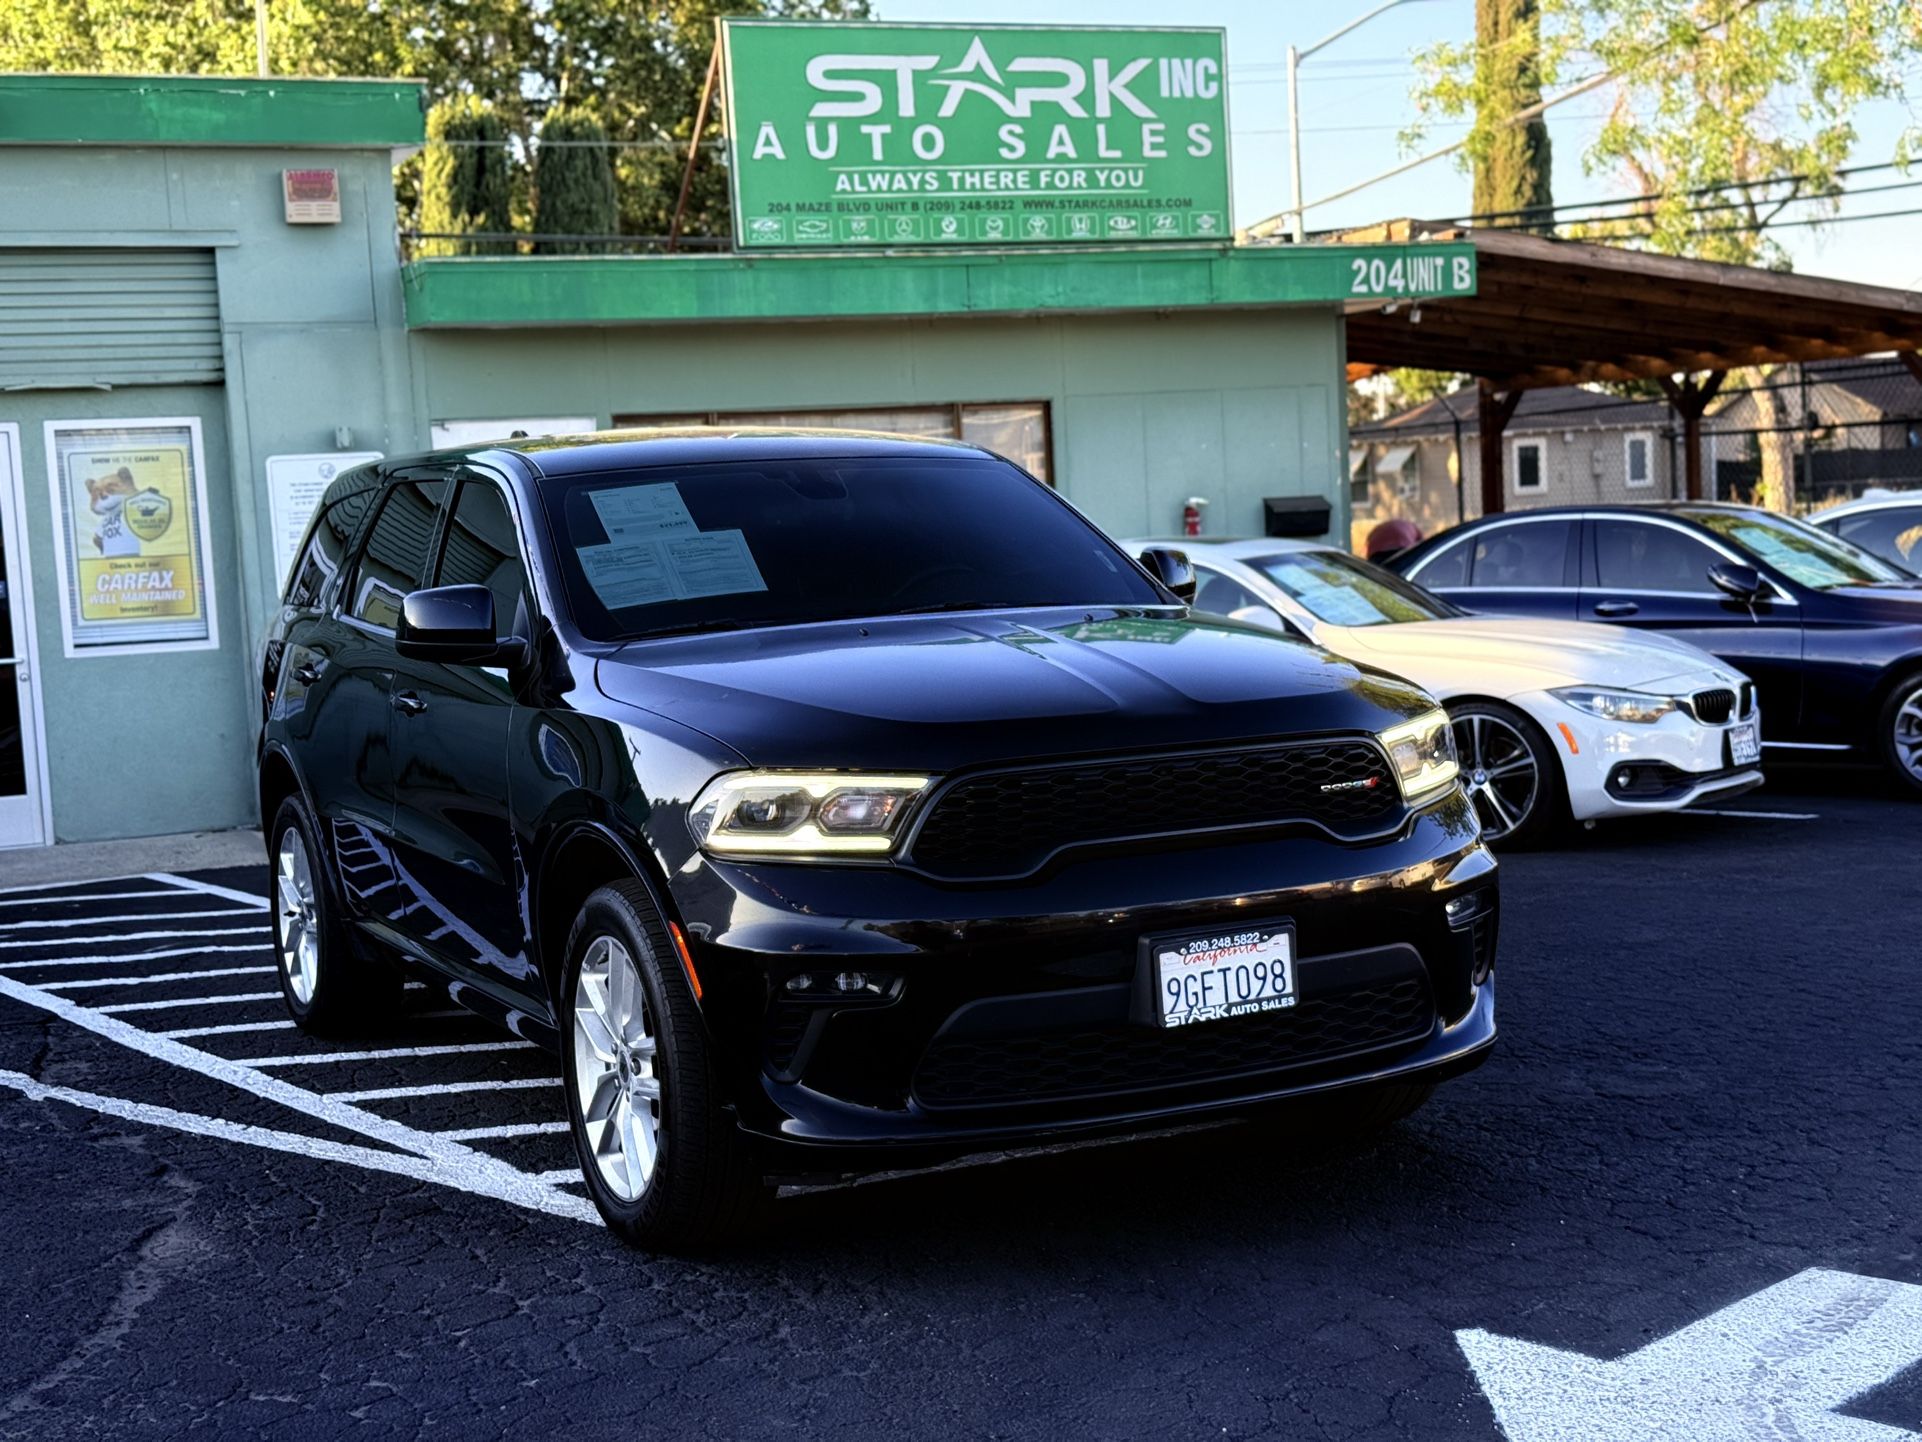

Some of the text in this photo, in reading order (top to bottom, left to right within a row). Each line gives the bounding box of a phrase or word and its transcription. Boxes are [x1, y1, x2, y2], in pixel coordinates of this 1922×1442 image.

[806, 35, 1219, 119] STARK INC
[752, 121, 1213, 161] AUTO SALES
[835, 168, 1144, 193] ALWAYS THERE FOR YOU
[767, 198, 1193, 214] 204 MAZE BLVD UNIT B (209) 248-5822 WWW.STARKCARSALES.COM
[1351, 256, 1471, 294] 204 UNIT B
[96, 570, 174, 592] CARFAX
[90, 590, 186, 604] WELL MAINTAINED
[1320, 780, 1371, 792] DODGE
[1183, 943, 1267, 966] California
[1189, 932, 1260, 953] 209.248.5822
[1167, 958, 1287, 1014] 9GFT098
[1165, 997, 1295, 1028] STARK AUTO SALES
